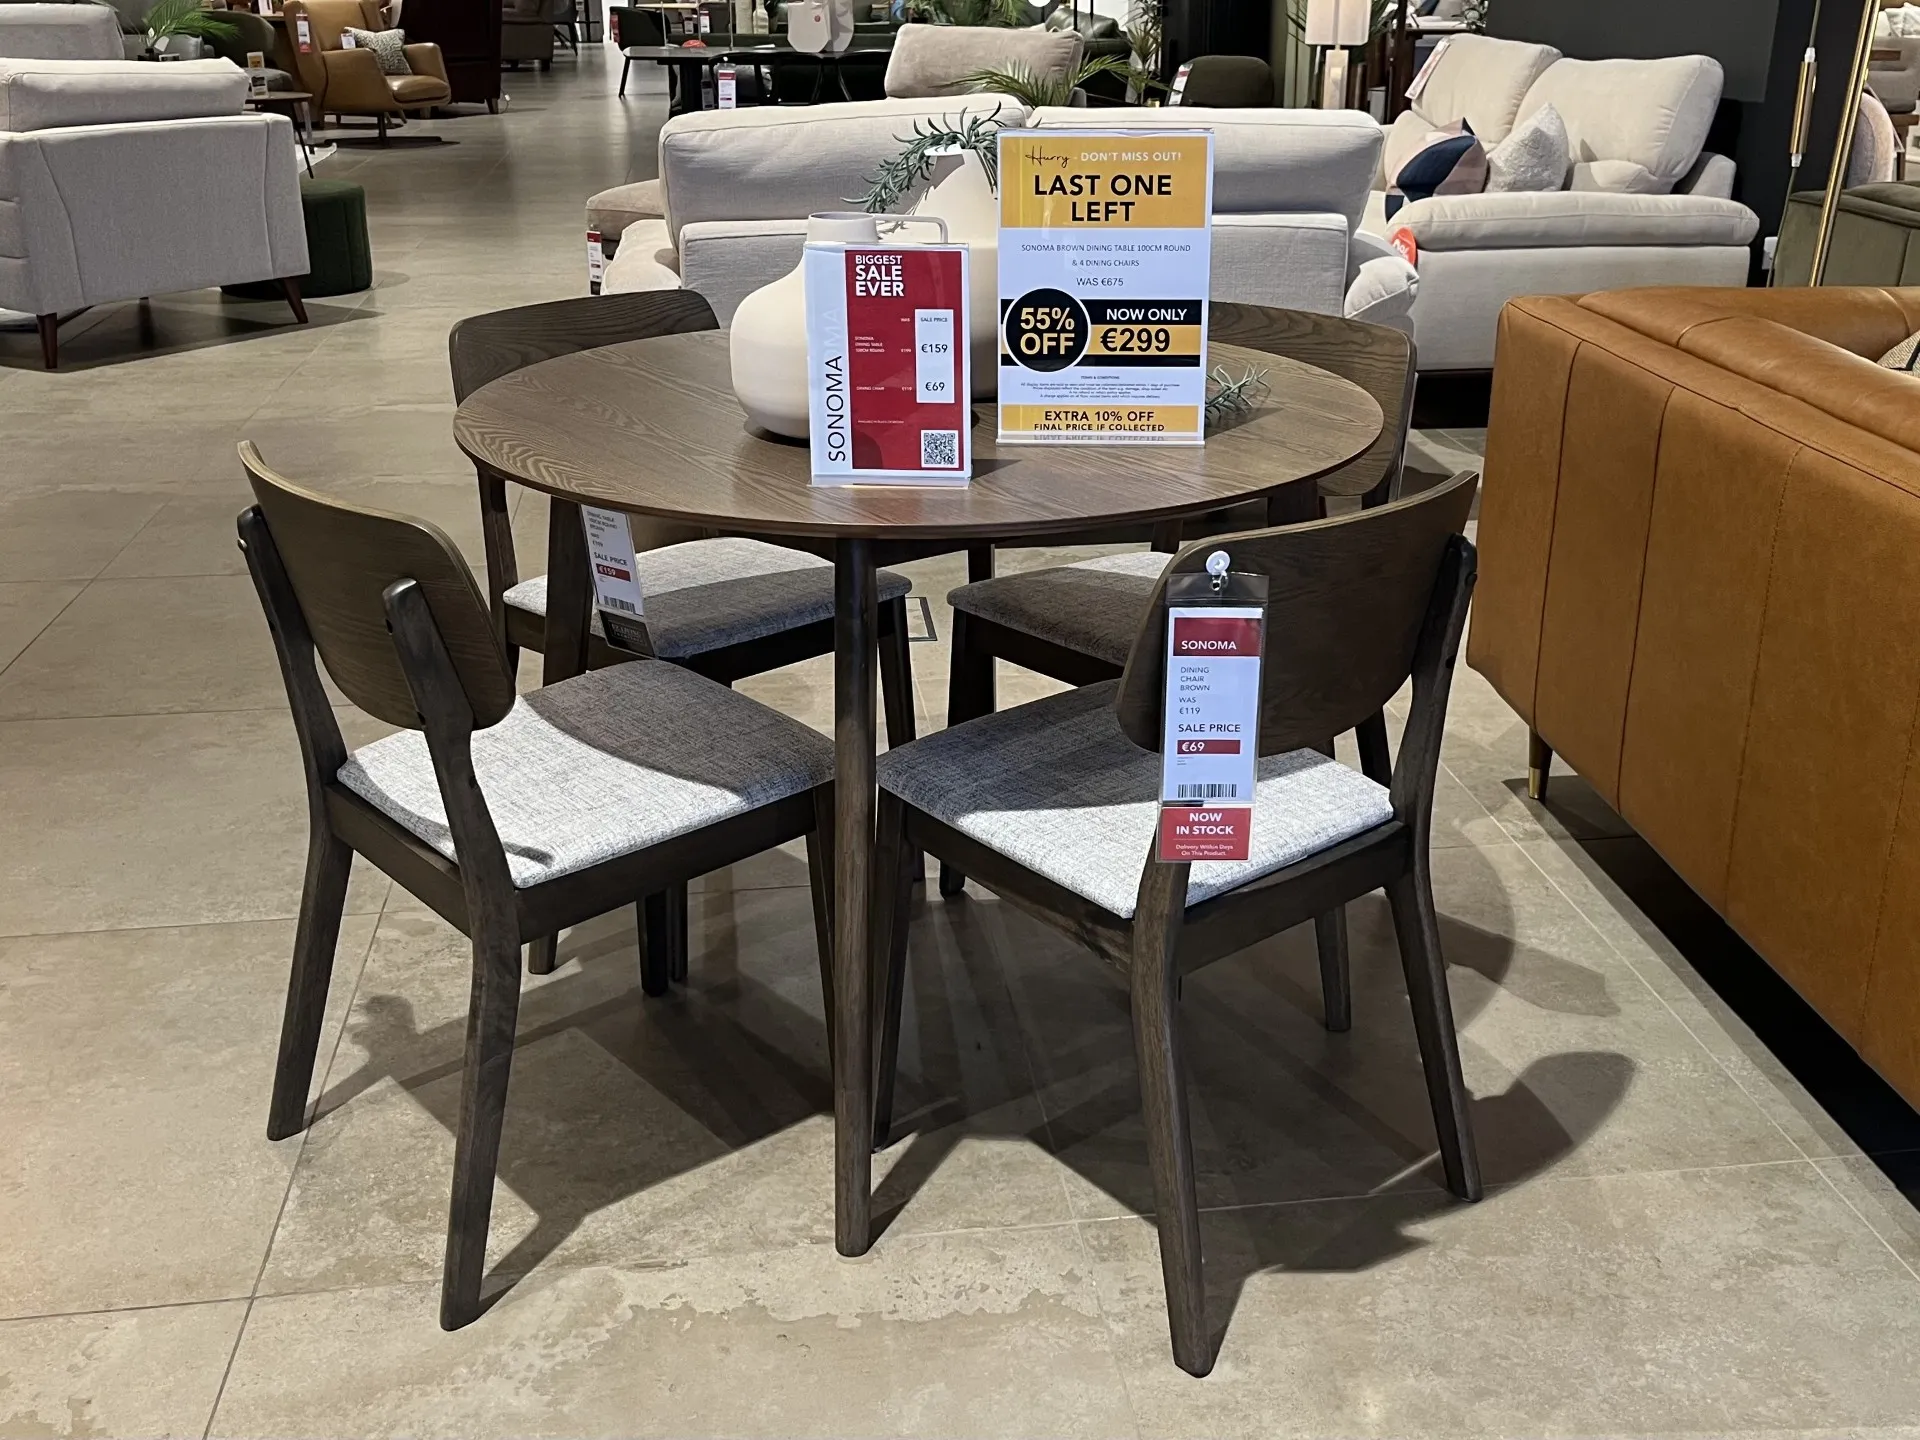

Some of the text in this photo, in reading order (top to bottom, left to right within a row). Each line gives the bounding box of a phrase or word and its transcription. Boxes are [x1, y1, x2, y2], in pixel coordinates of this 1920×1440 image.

[1025, 145, 1070, 168] Hurry
[1080, 152, 1118, 162] DON'T
[1122, 152, 1148, 162] MISS
[1152, 152, 1182, 162] OUT!
[1034, 174, 1172, 196] LAST ONE
[1072, 202, 1136, 222] LEFT
[856, 255, 902, 265] BIGGEST
[856, 266, 902, 280] SALE
[1076, 278, 1124, 286] WAS €675
[856, 282, 904, 296] EVER
[1020, 307, 1075, 330] 55%
[1106, 308, 1188, 320] NOW ONLY
[1020, 332, 1076, 356] OFF
[1100, 328, 1170, 352] €299
[922, 344, 948, 353] €159
[926, 382, 945, 391] €69
[825, 356, 846, 462] SONOMA
[1044, 410, 1154, 422] EXTRA 10% OFF
[594, 552, 628, 566] SALE PRICE
[599, 566, 616, 576] €159
[1181, 640, 1237, 650] SONOMA
[1178, 724, 1241, 732] SALE PRICE
[1182, 742, 1205, 752] €69
[1189, 812, 1222, 822] NOW
[1176, 826, 1234, 834] IN STOCK
